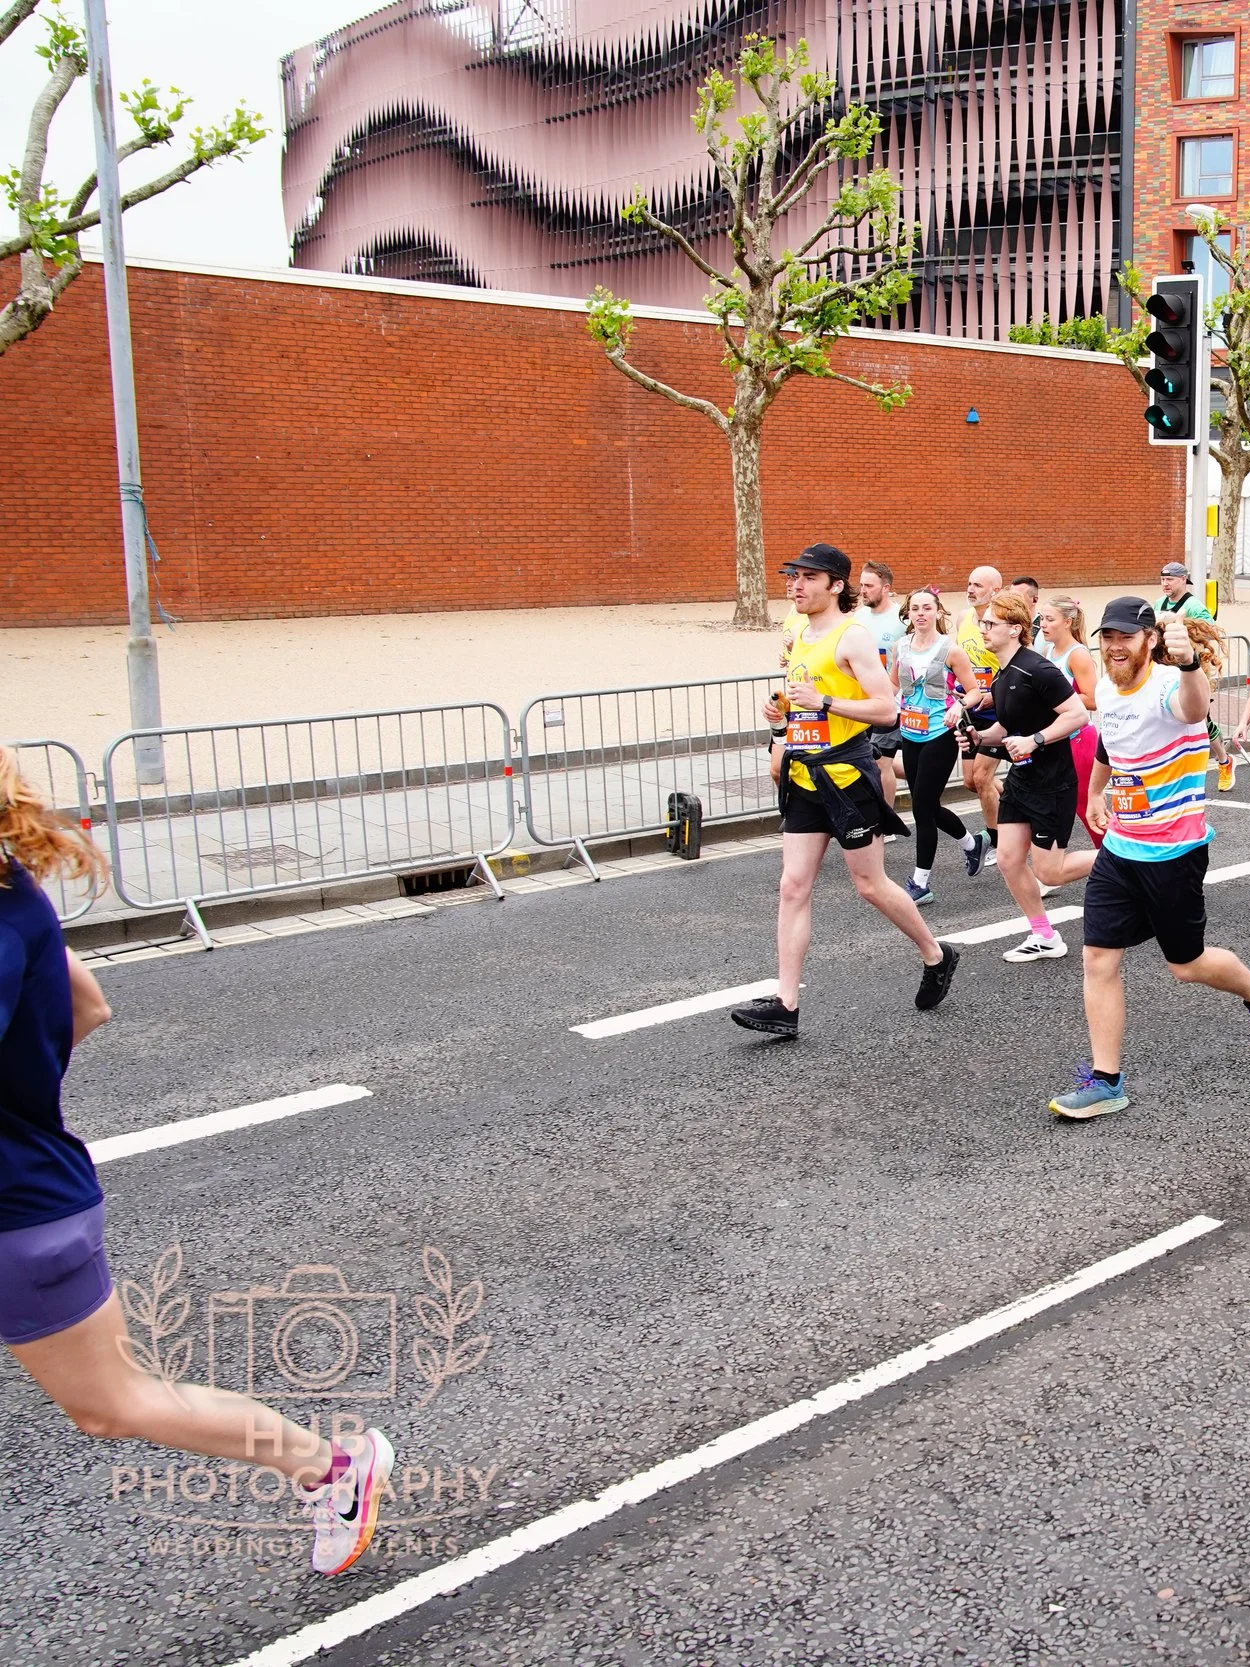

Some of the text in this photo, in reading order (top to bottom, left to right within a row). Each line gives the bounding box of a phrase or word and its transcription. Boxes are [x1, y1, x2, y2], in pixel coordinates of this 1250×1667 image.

[904, 718, 922, 728] 4117
[792, 729, 820, 741] 6015
[1117, 797, 1133, 810] 397
